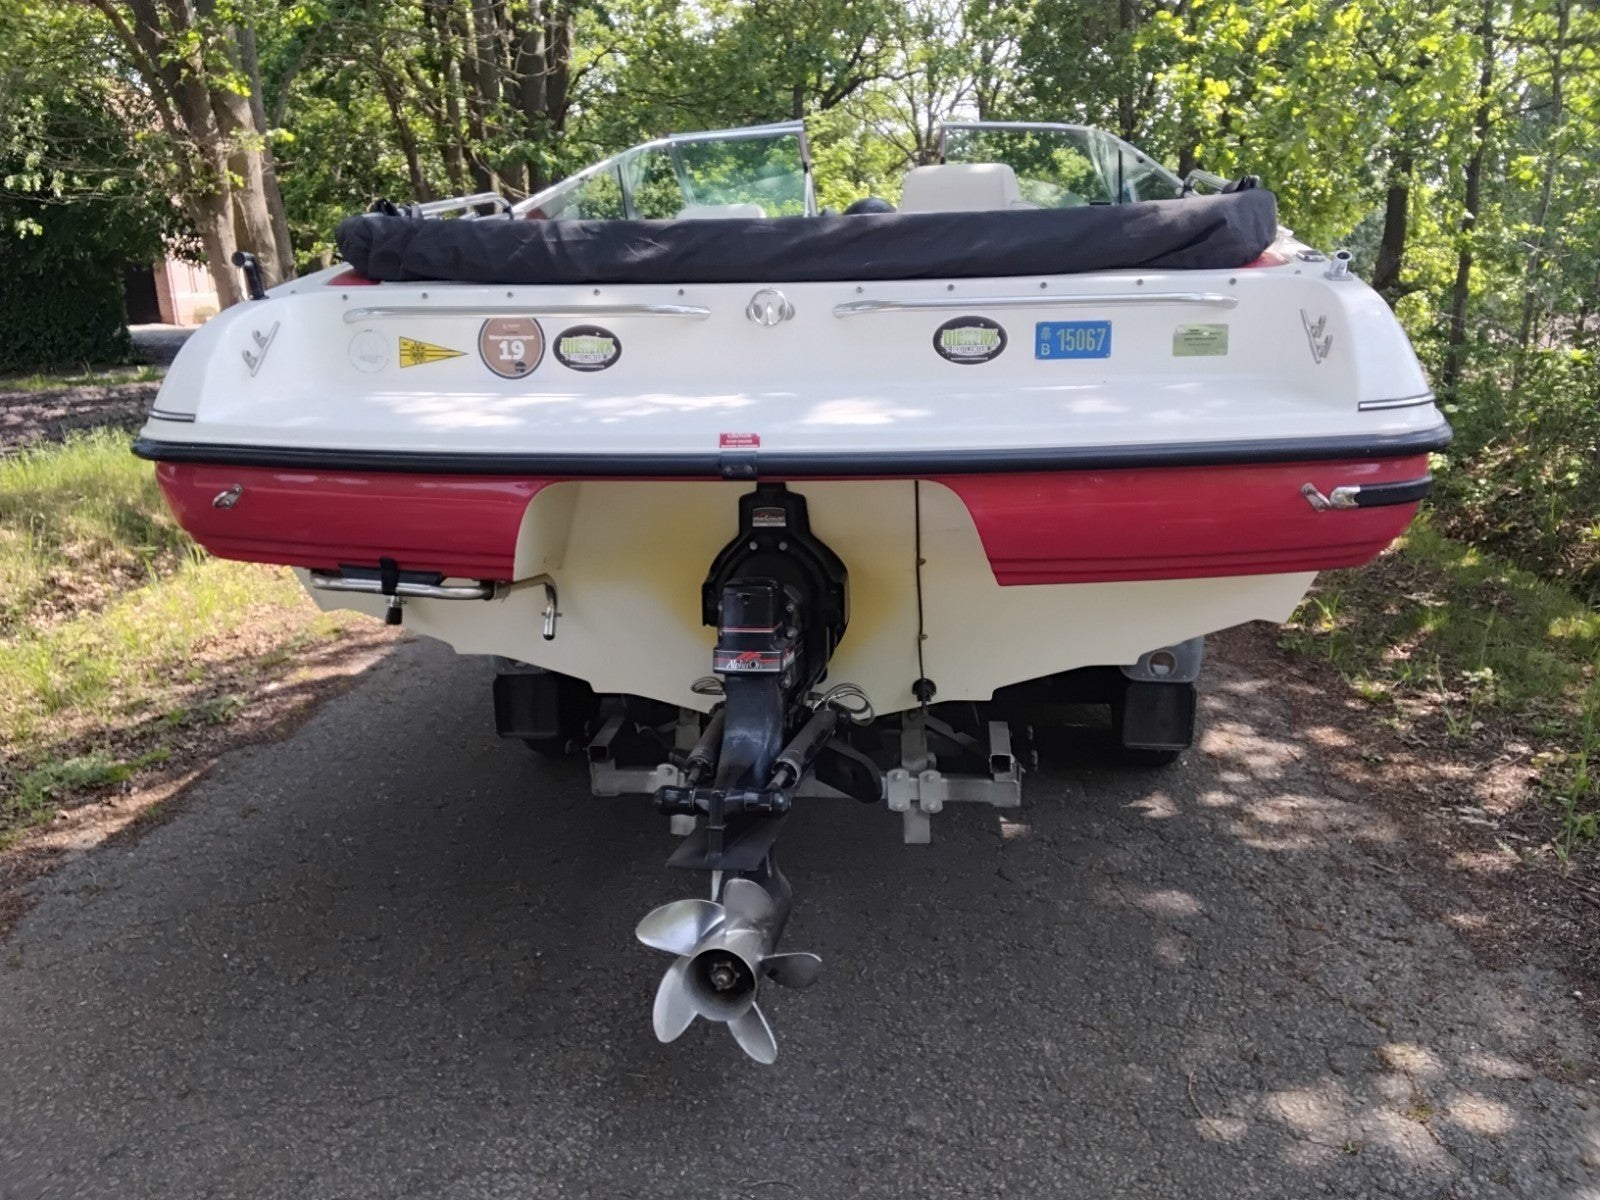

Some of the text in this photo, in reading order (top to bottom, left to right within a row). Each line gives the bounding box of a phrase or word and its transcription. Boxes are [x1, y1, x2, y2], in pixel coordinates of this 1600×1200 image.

[1041, 343, 1050, 355] B
[1056, 327, 1107, 351] 15067
[499, 340, 525, 360] 19
